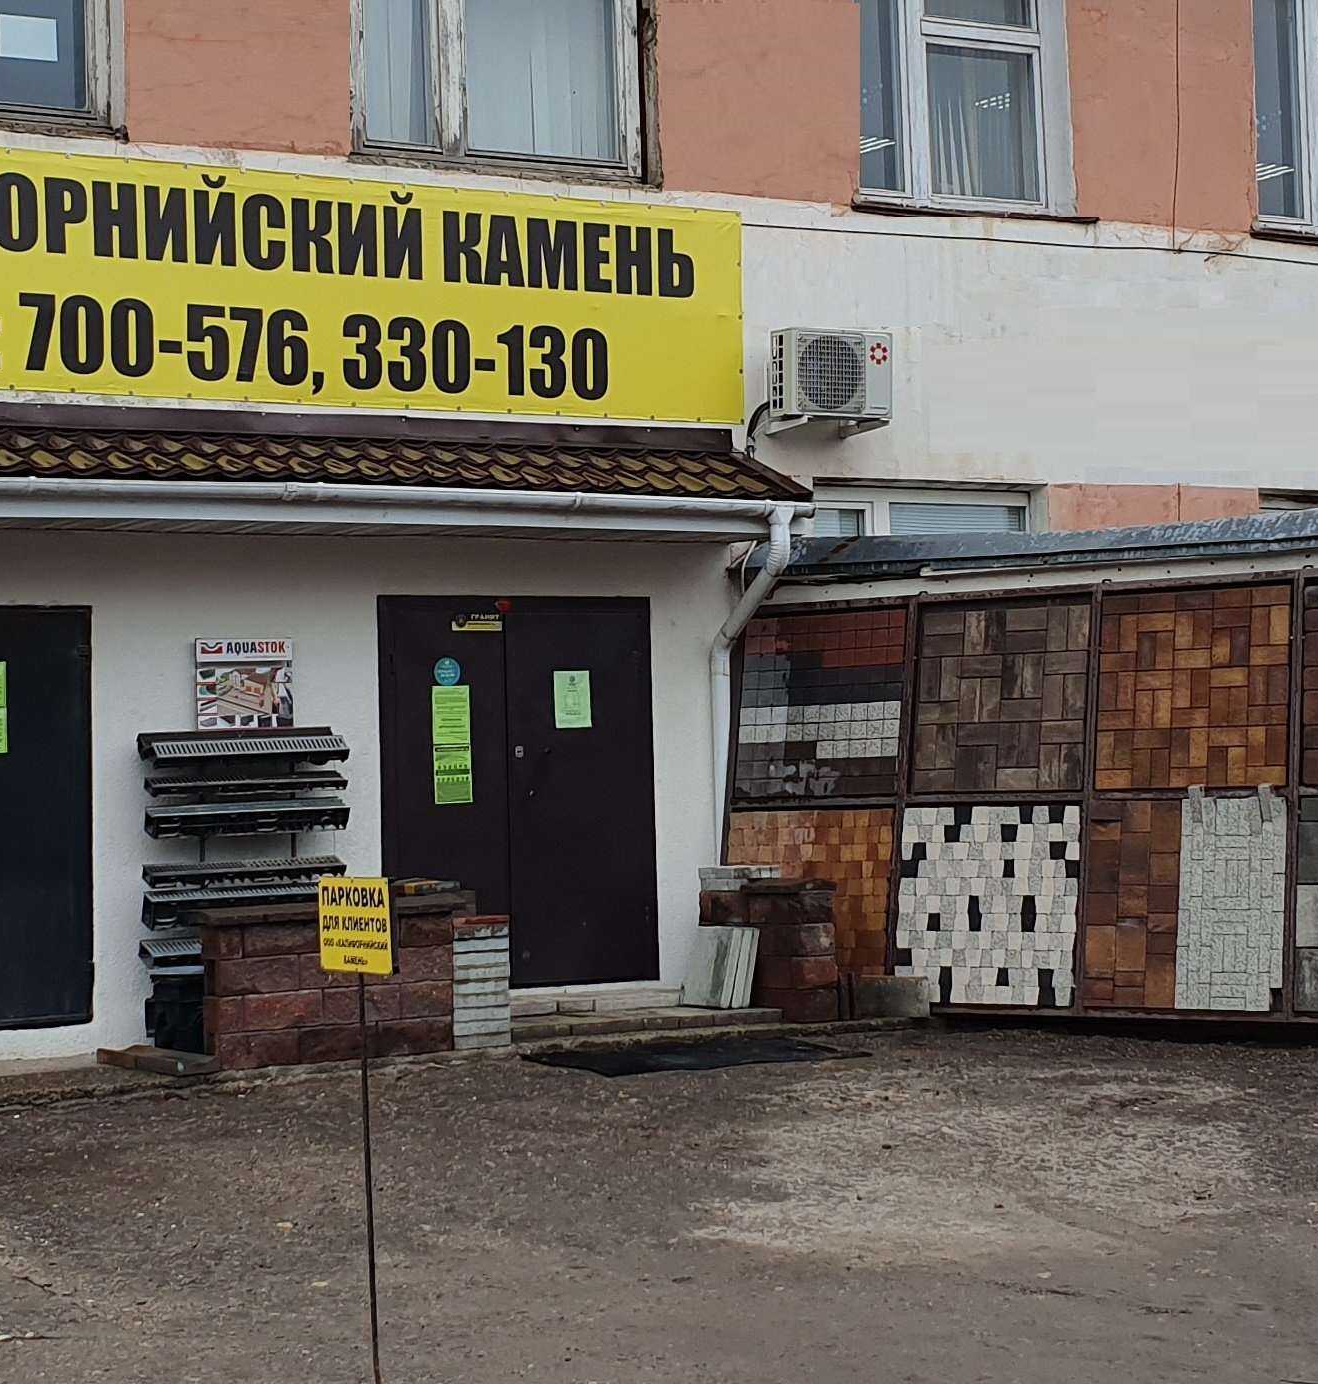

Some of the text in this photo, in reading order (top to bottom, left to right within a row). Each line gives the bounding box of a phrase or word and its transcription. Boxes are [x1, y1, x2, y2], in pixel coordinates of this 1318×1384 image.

[443, 209, 695, 299] КАМЕНЬ
[19, 292, 326, 396] 700-576,
[342, 312, 609, 401] 330-130
[226, 641, 286, 656] AQUASTOK
[322, 886, 385, 908] ПАРКОВКА
[323, 915, 387, 933] ДЛЯ КЛИЕНТОВ
